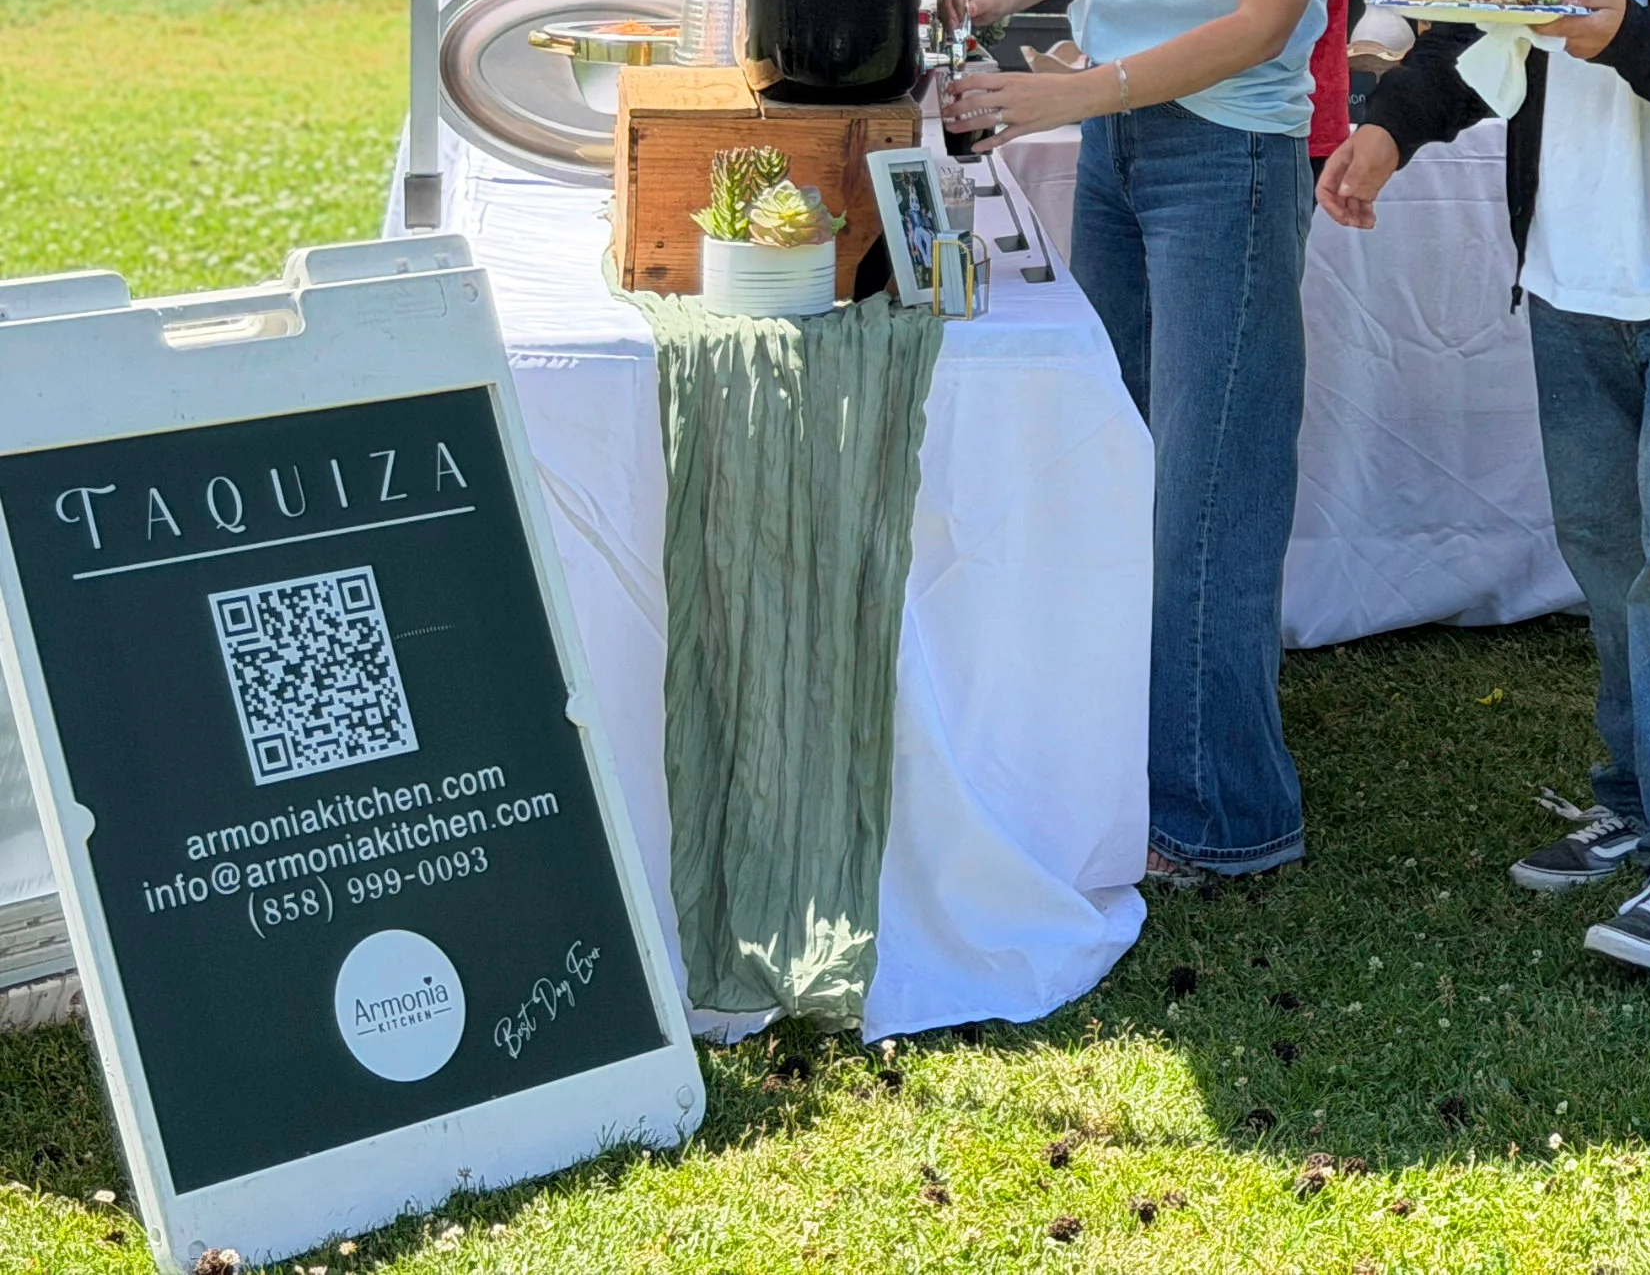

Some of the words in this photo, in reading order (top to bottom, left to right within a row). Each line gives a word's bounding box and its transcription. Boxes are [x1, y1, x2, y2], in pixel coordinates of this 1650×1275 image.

[55, 441, 468, 549] TAQUIZA
[143, 792, 559, 913] info@armoniakitchen.com
[186, 765, 506, 861] armoniakitchen.com
[248, 876, 334, 939] (858)
[347, 846, 489, 904] 999-0093
[355, 976, 449, 1026] Armonia
[378, 1010, 432, 1033] KITCHEN
[494, 1002, 536, 1059] Best
[533, 978, 575, 1021] Day
[566, 940, 600, 985] Ever
